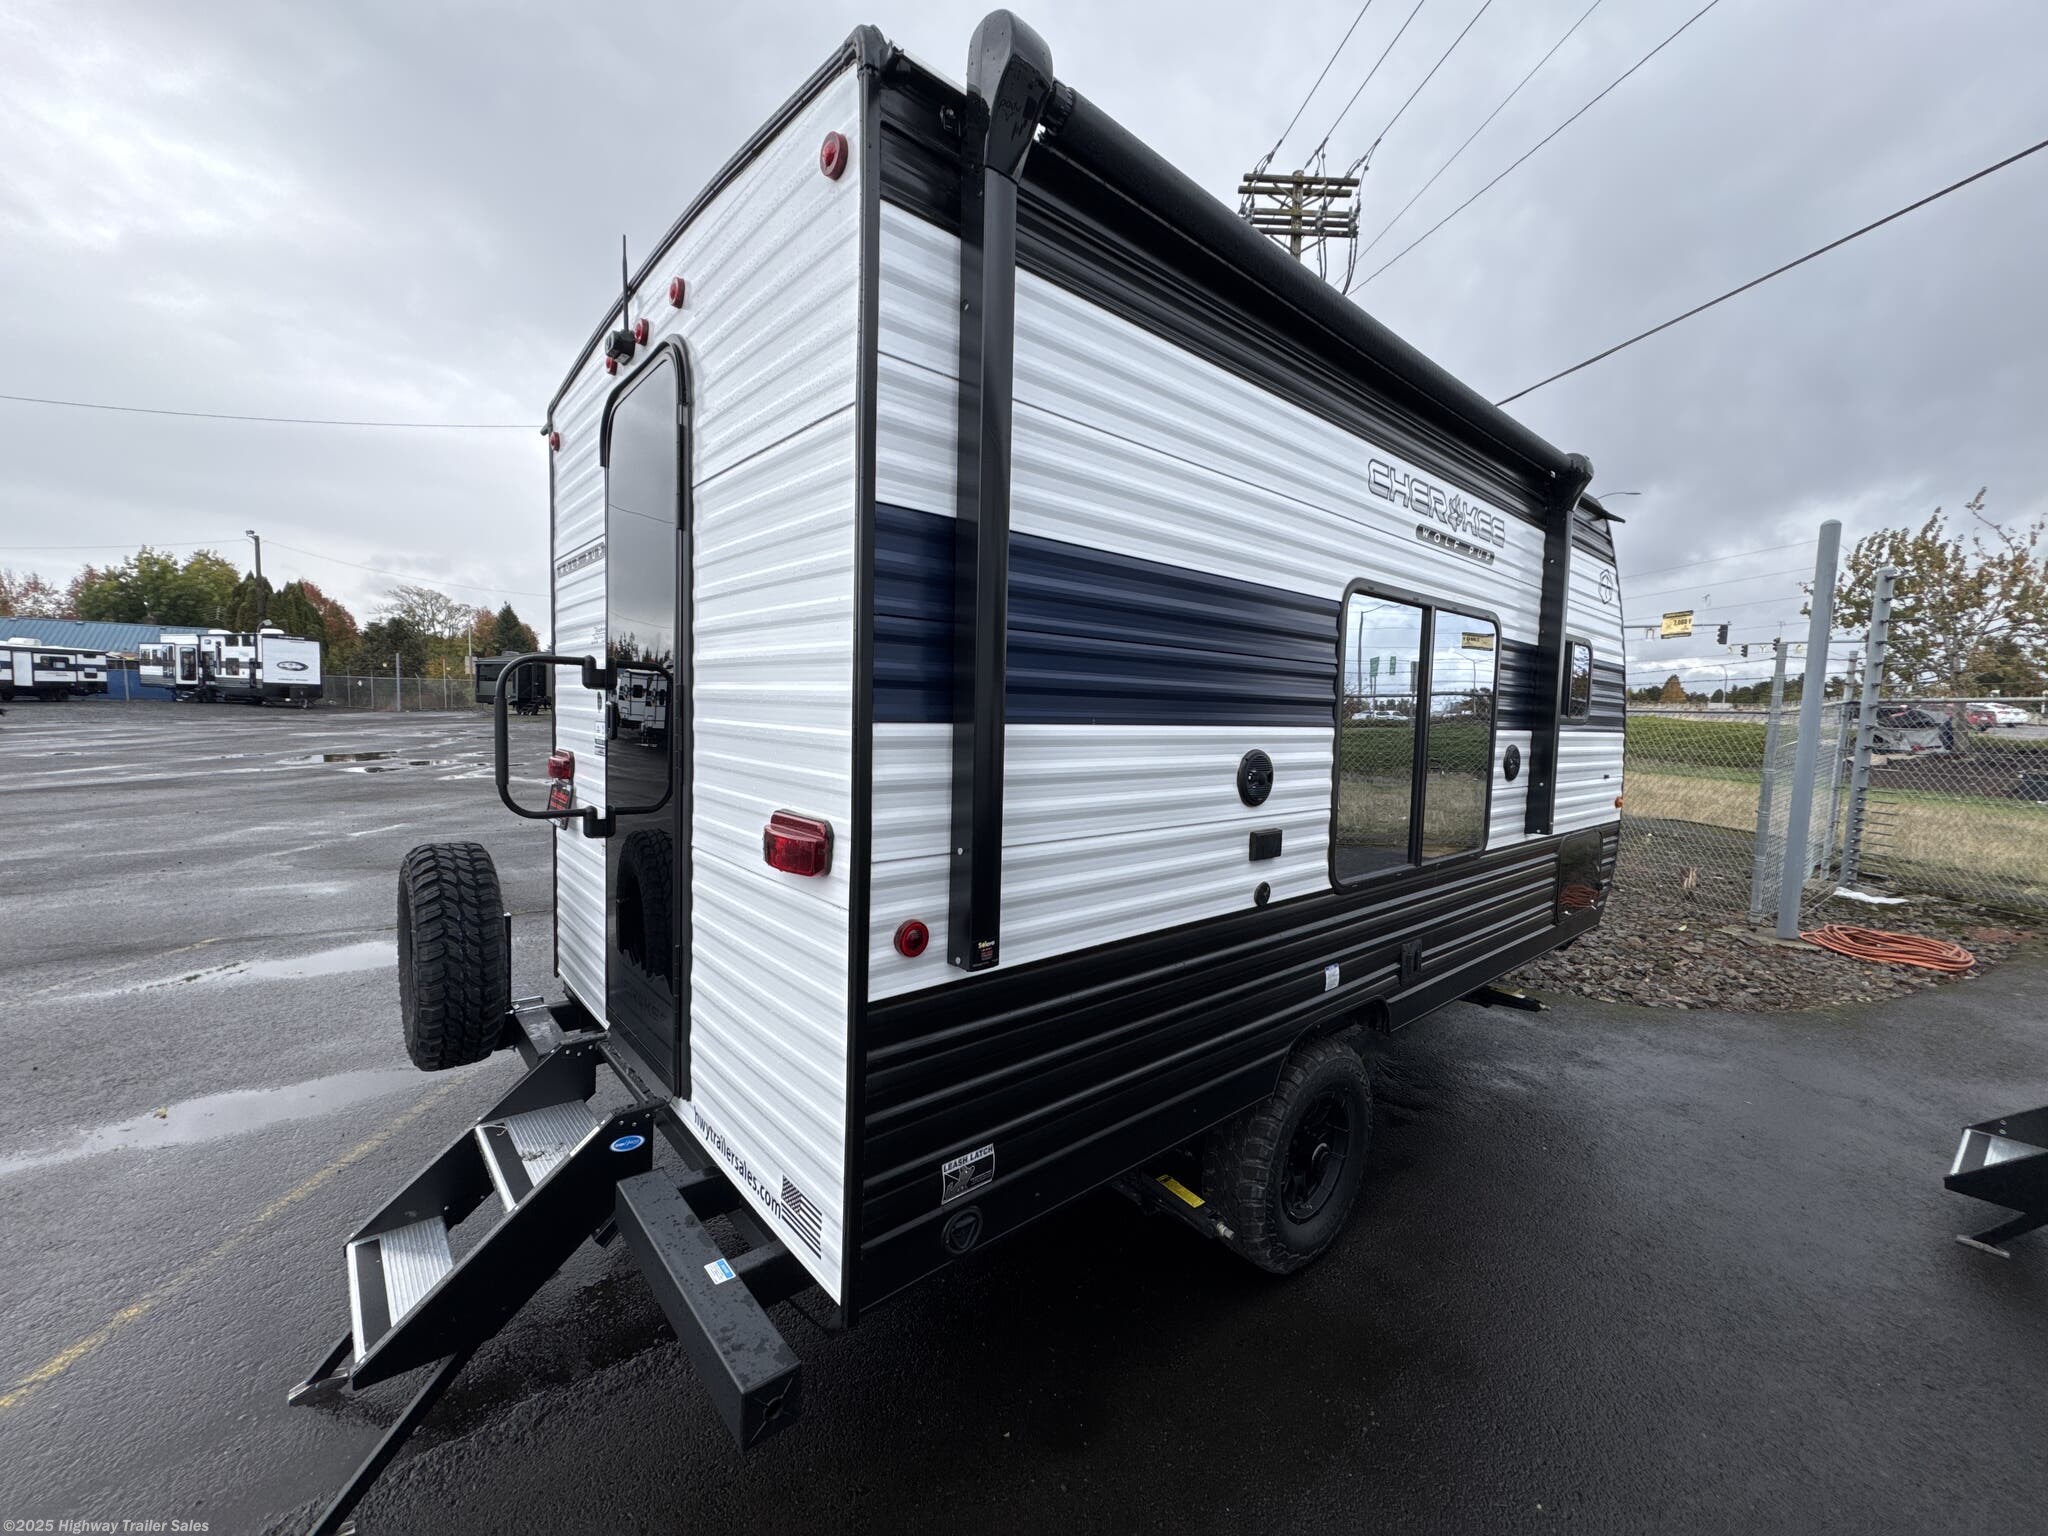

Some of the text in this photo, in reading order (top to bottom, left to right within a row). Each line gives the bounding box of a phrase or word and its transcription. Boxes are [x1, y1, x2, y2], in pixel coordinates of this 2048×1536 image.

[1422, 527, 1491, 561] WOLF PUP
[693, 1106, 782, 1219] hwytrailersales.com
[943, 1145, 993, 1172] LEASH LATCH
